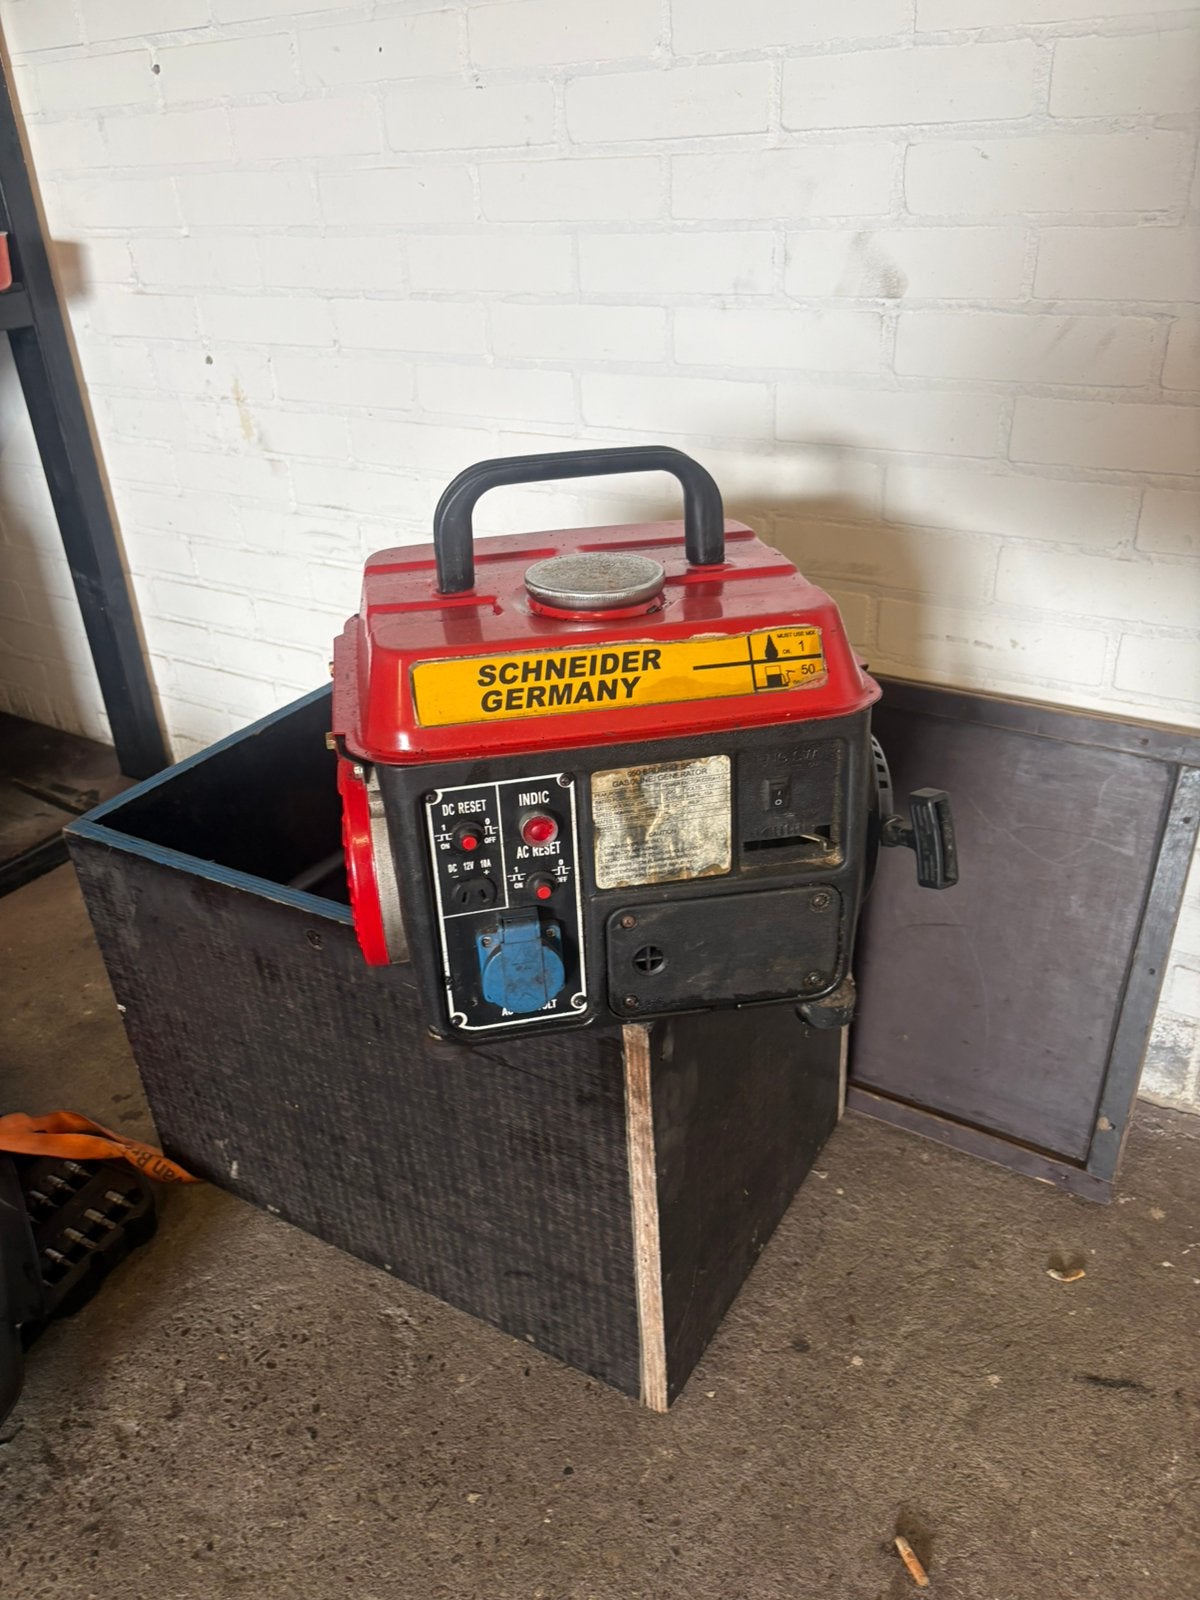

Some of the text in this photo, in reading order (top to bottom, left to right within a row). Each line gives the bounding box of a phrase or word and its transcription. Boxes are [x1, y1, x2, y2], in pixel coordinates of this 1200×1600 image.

[798, 640, 805, 652] 1
[477, 649, 662, 687] SCHNEIDER
[801, 663, 816, 675] 50
[481, 676, 641, 712] GERMANY
[657, 767, 708, 781] GENERATOR
[518, 790, 550, 807] INDIC
[442, 799, 487, 817] DC RESET
[484, 836, 497, 844] OFF
[516, 841, 561, 860] AC RESET
[447, 863, 458, 873] DC
[463, 861, 474, 871] 12V
